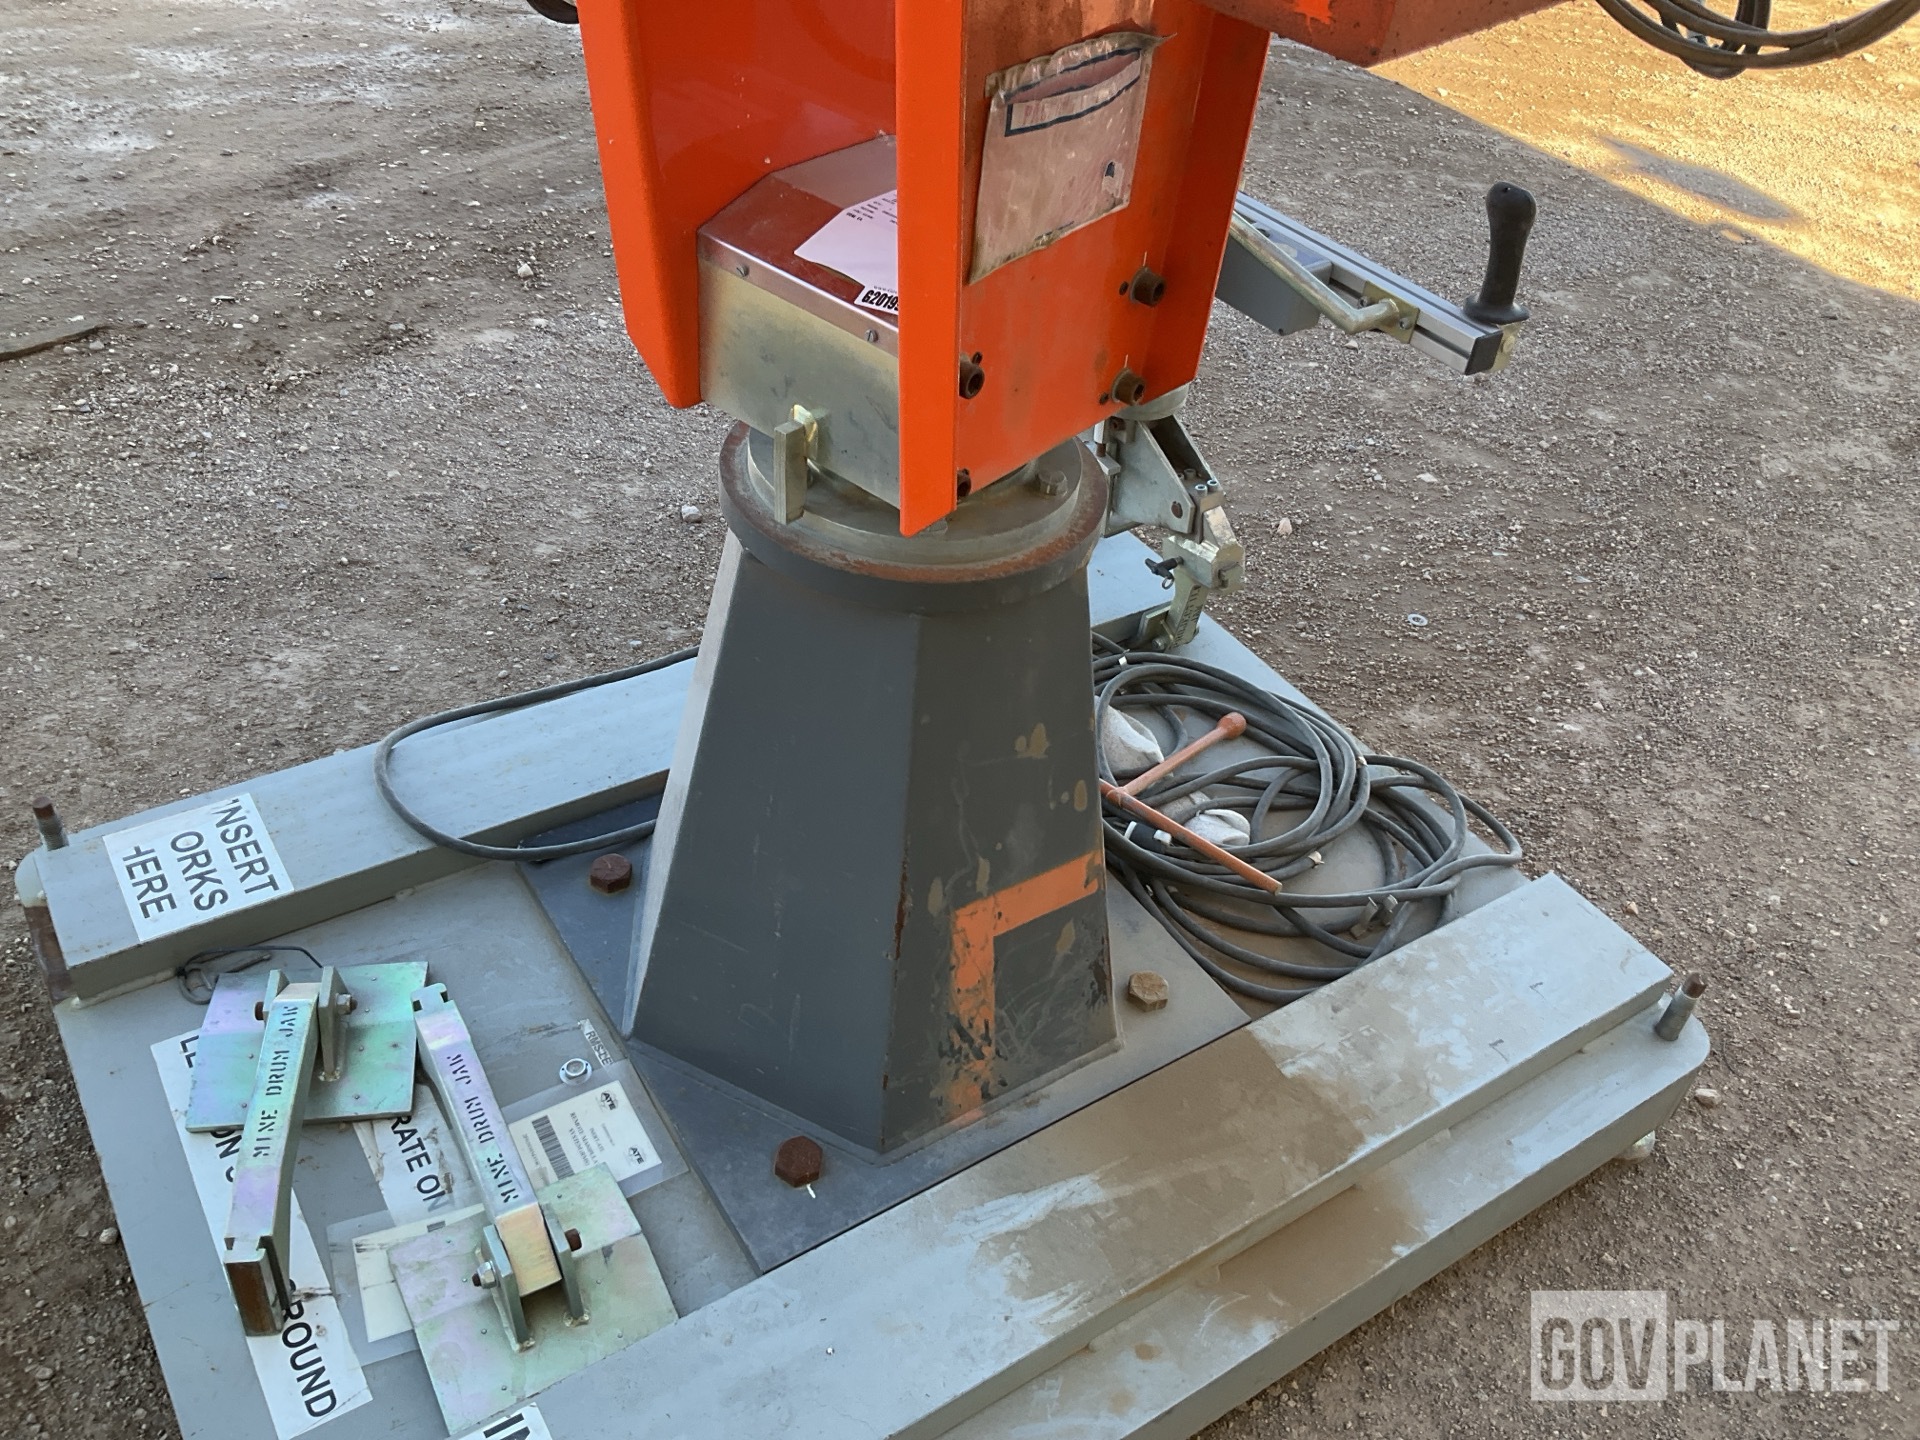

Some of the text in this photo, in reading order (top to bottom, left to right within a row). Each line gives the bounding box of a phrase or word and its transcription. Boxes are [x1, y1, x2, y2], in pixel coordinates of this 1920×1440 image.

[212, 798, 280, 895] NSERT
[252, 1006, 298, 1158] MINE DRUM JAW
[446, 1053, 519, 1204] MINE DRUM JAW
[601, 1091, 618, 1111] ATE
[629, 1146, 645, 1165] ATE
[281, 1279, 337, 1418] ROUND
